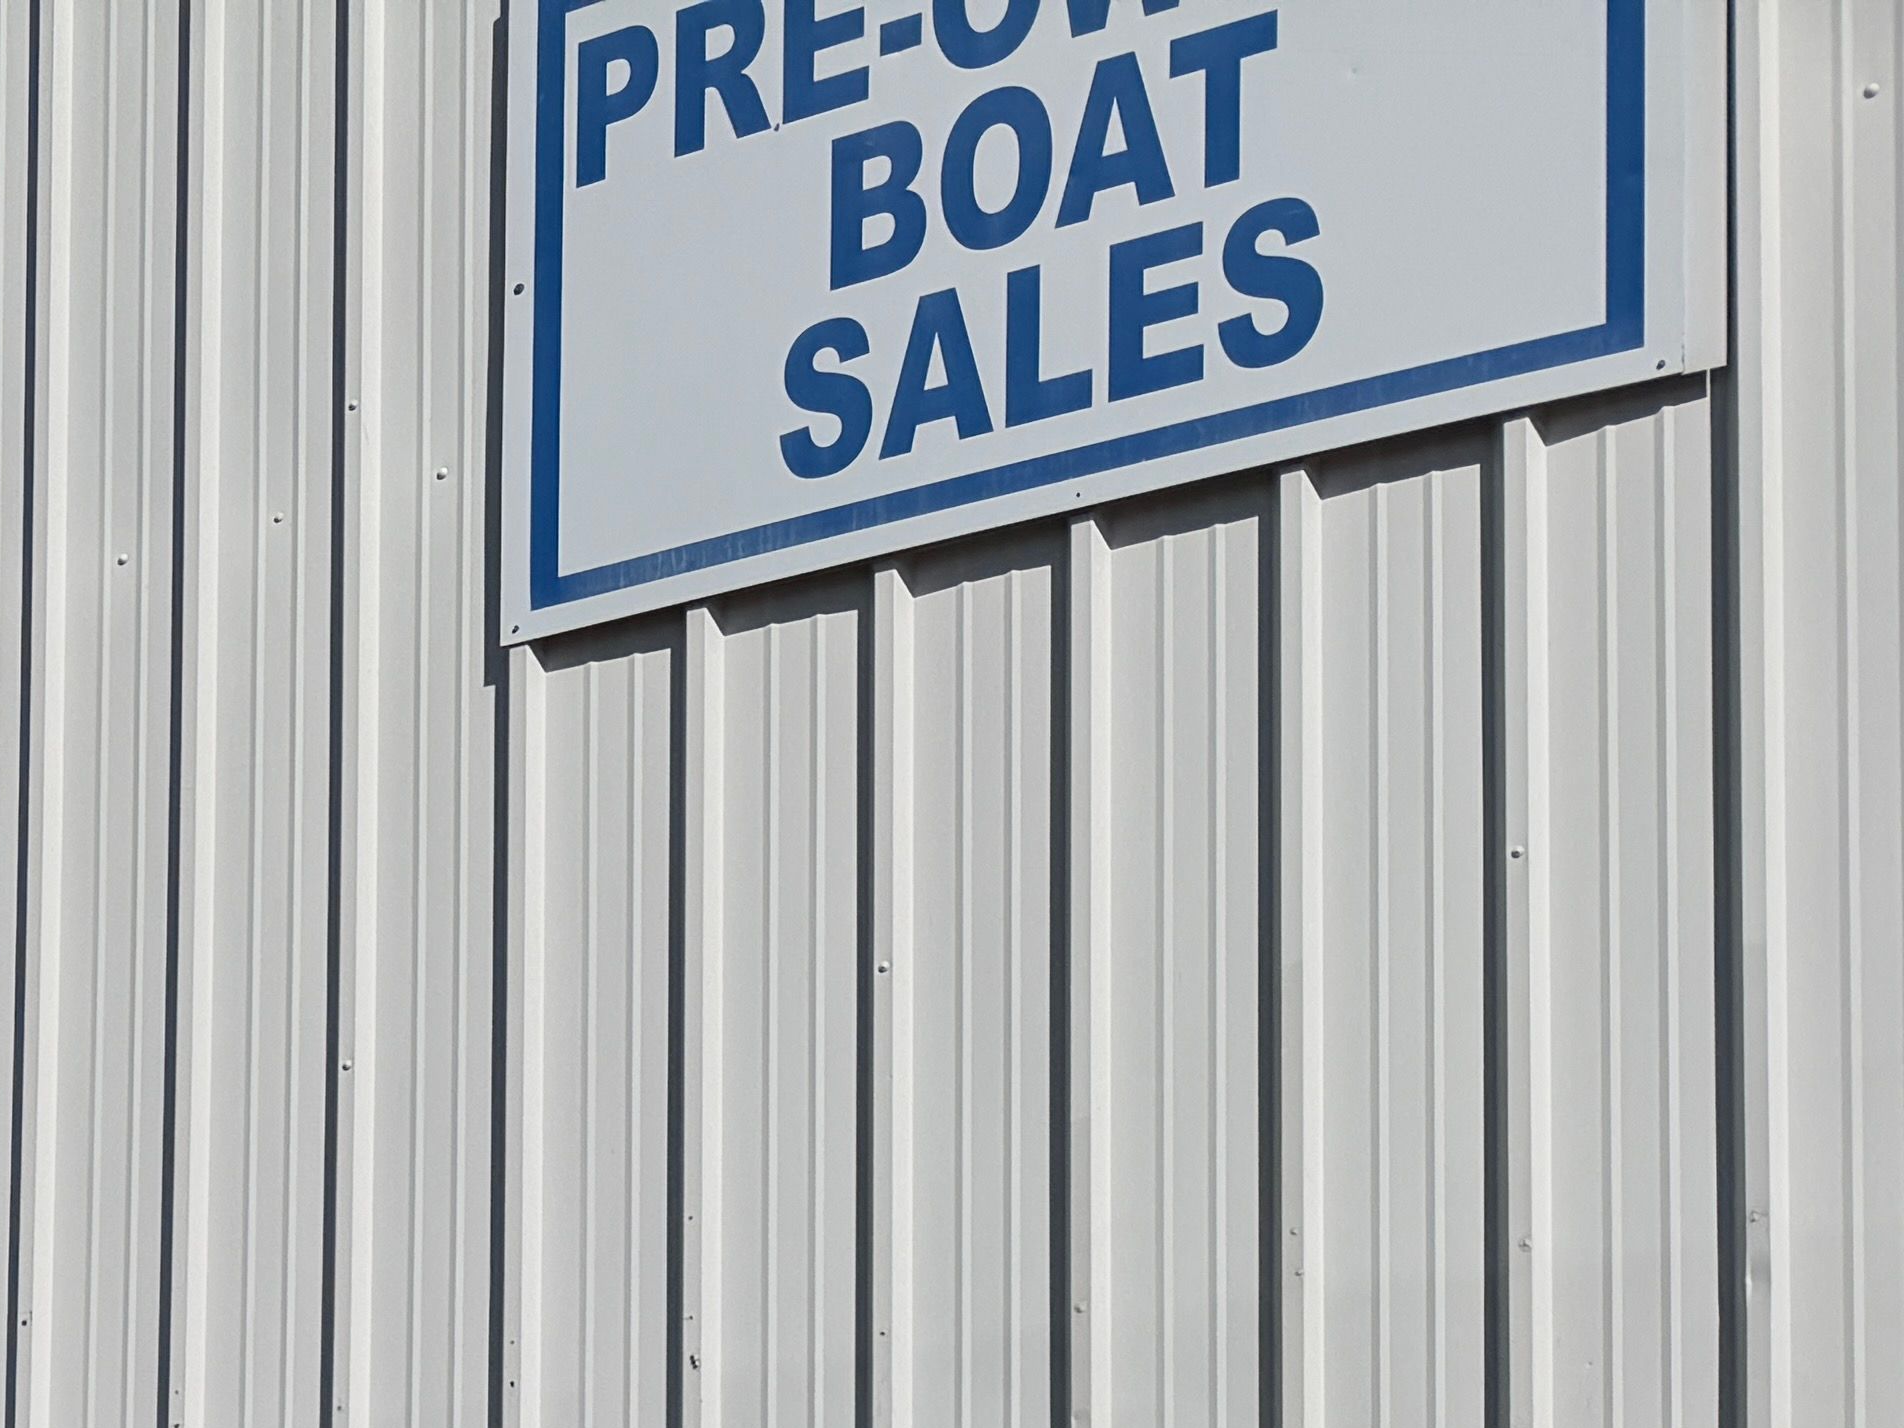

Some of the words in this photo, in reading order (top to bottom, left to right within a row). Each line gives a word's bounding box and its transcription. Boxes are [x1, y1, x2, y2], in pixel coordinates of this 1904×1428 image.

[576, 0, 1180, 189] PRE-O
[830, 9, 1278, 291] BOAT
[779, 197, 1324, 479] SALES
